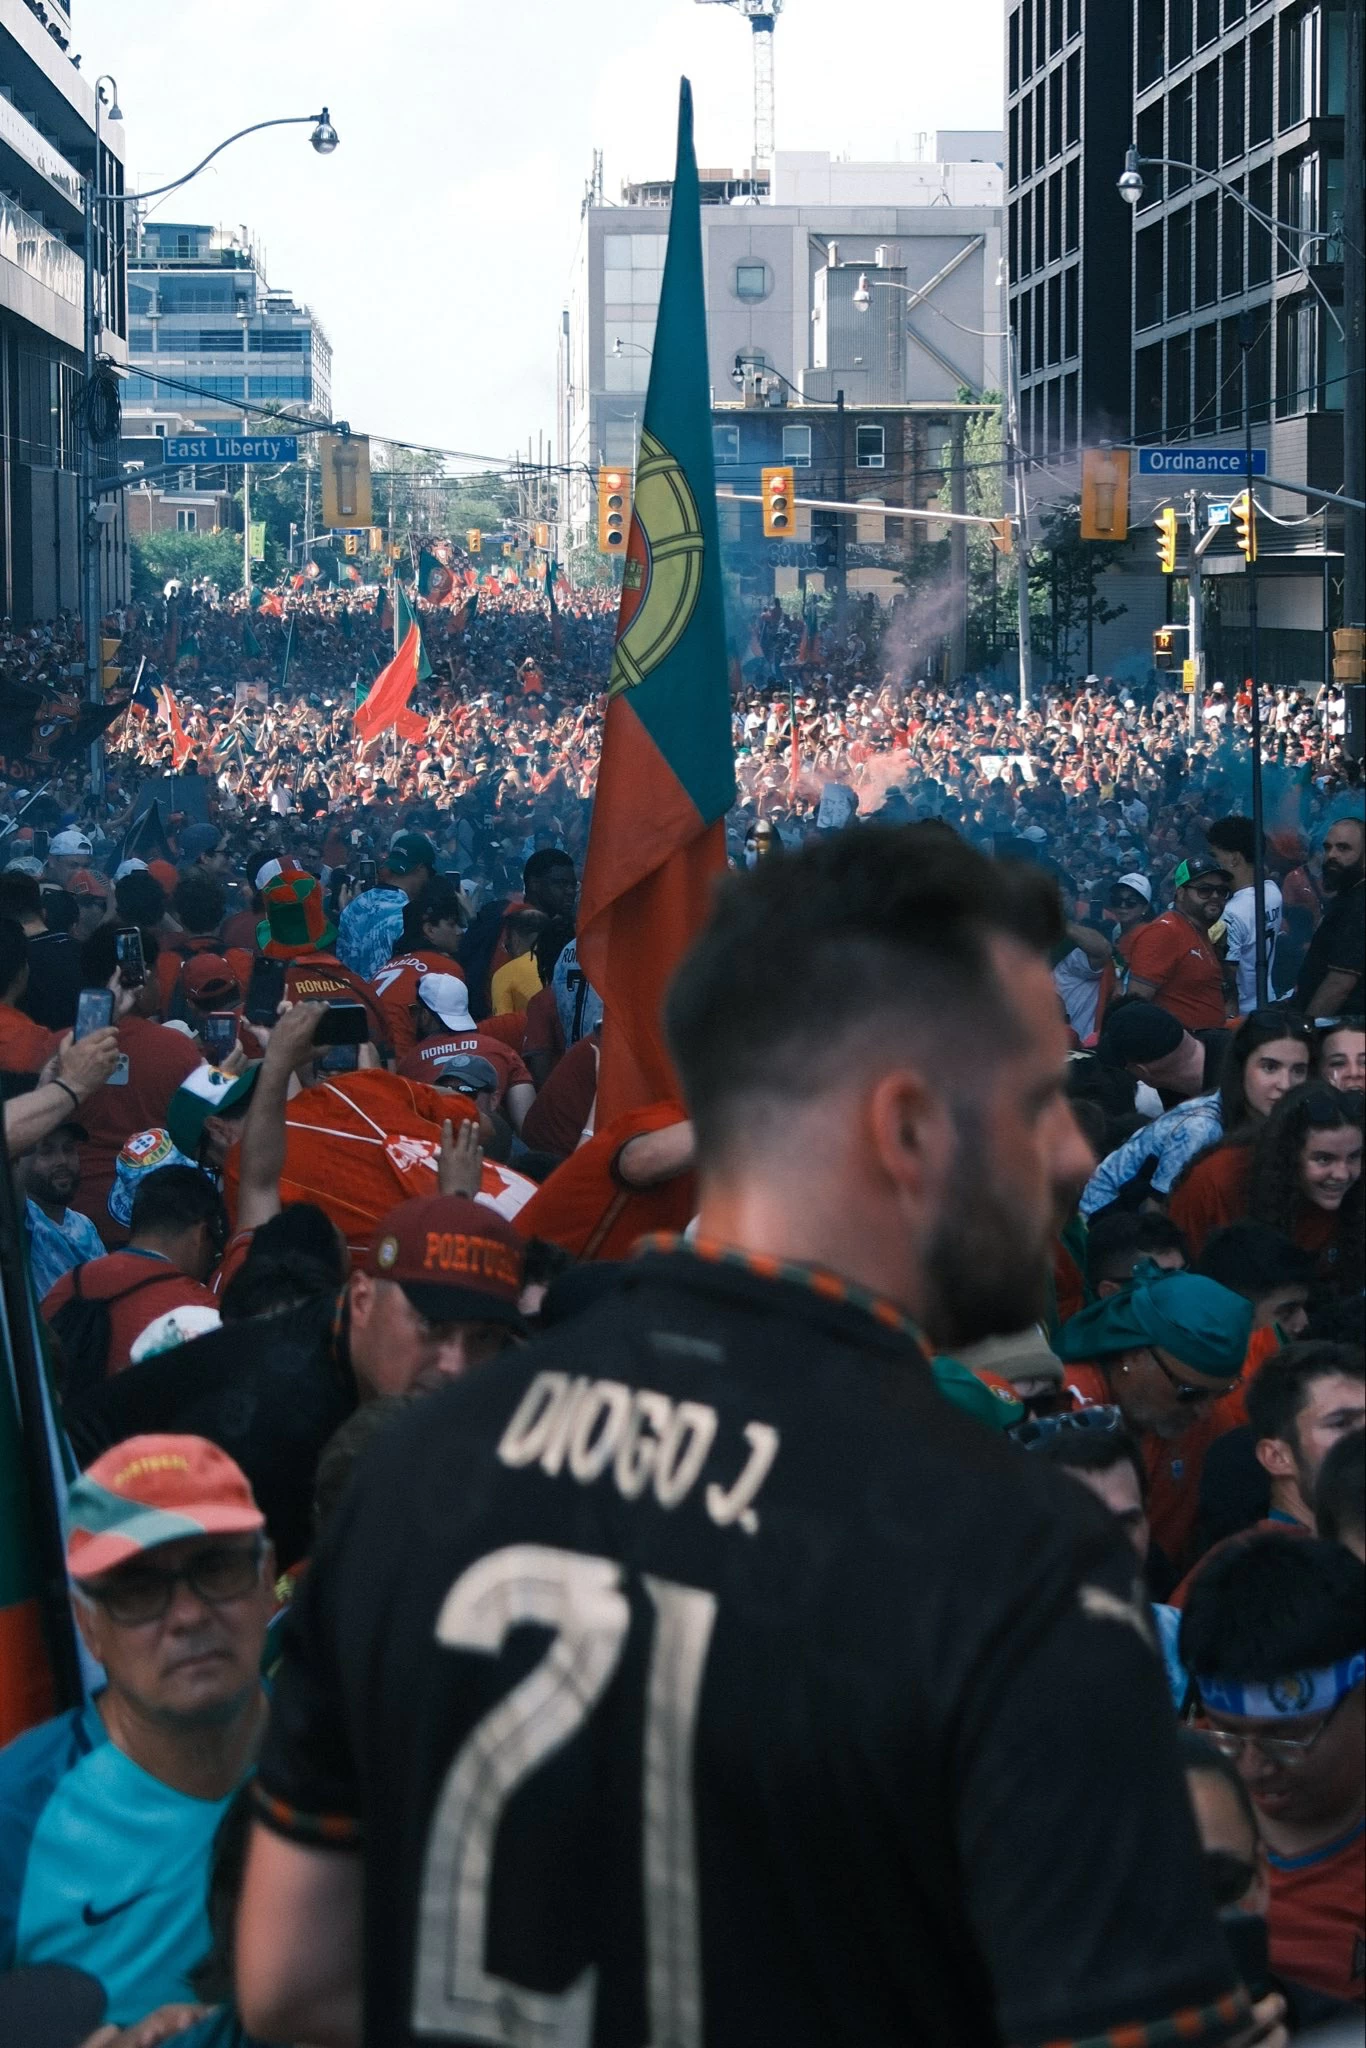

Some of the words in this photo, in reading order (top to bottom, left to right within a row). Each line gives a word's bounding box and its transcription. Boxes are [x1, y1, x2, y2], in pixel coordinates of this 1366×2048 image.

[167, 439, 207, 457] East
[215, 438, 281, 461] Liberty
[284, 438, 295, 448] St
[1150, 452, 1241, 470] Ordnance
[421, 1040, 478, 1060] RONALDO
[498, 1369, 719, 1511] DIOGO
[706, 1420, 780, 1537] J.
[413, 1543, 718, 2048] 21
